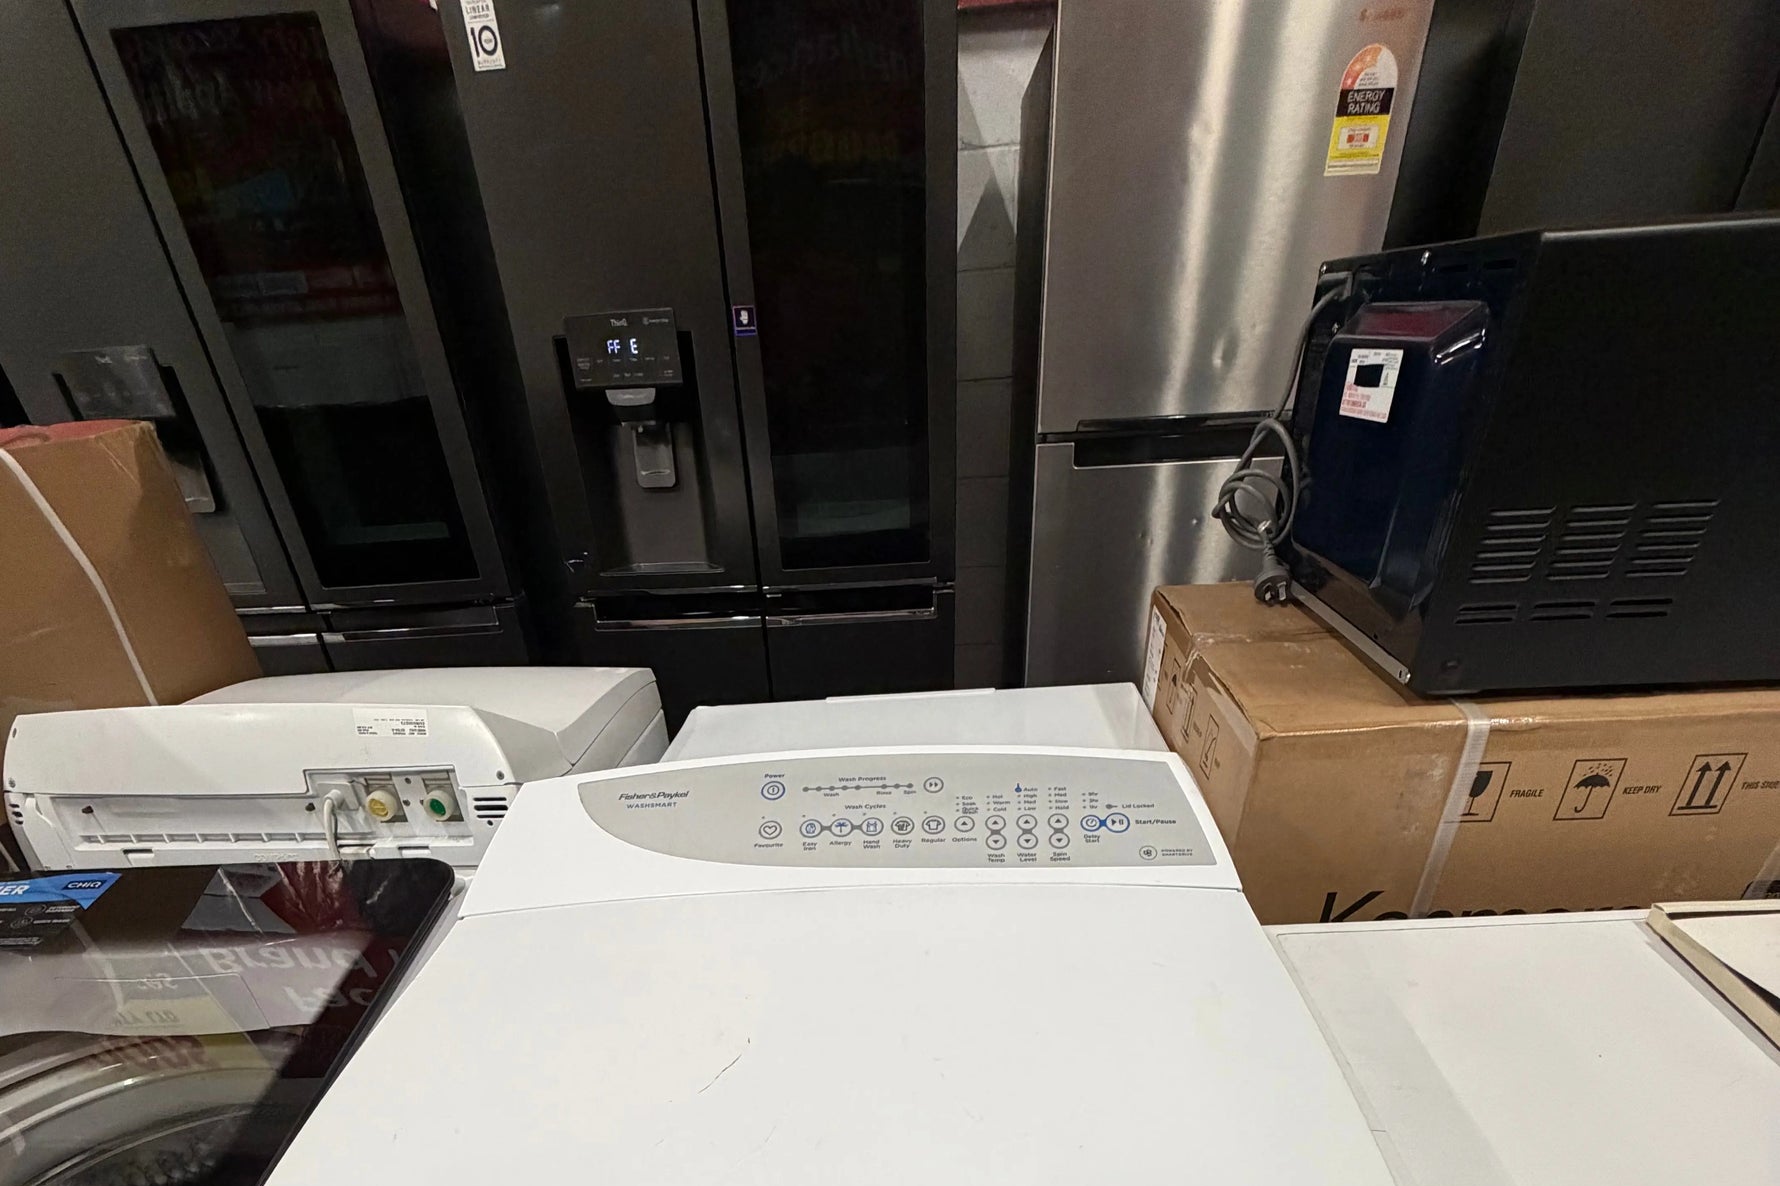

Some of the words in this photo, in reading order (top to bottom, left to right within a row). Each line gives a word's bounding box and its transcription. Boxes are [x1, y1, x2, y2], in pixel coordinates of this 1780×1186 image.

[470, 25, 498, 57] 10
[1347, 90, 1386, 103] ENERGY
[1347, 102, 1382, 115] RATING
[1509, 788, 1544, 798] FRAGILE
[1622, 786, 1644, 795] KEEP
[1644, 784, 1662, 795] DRY
